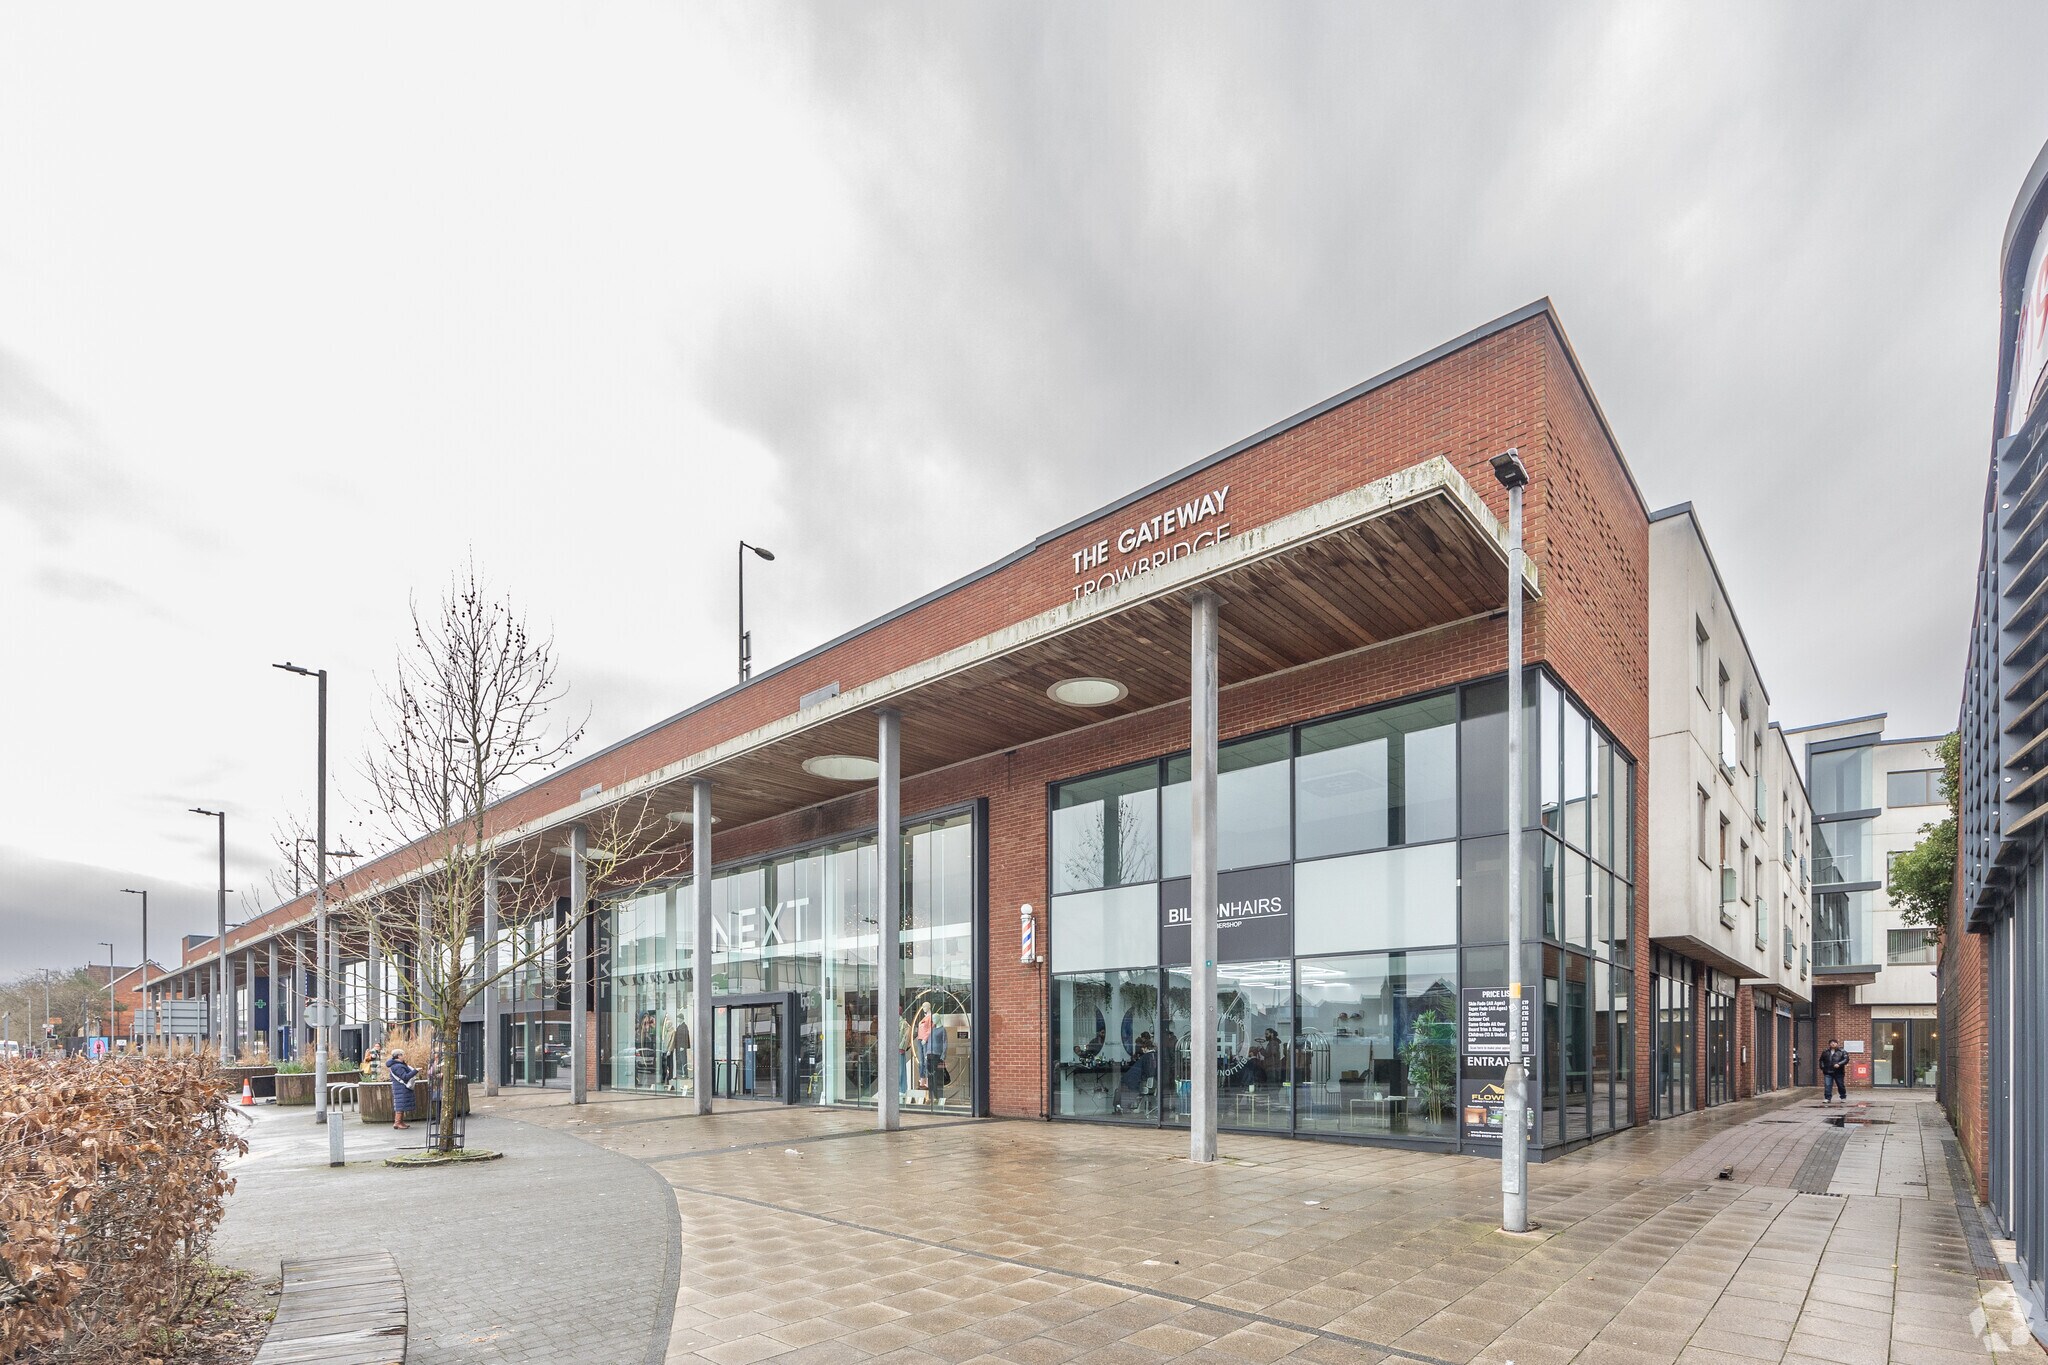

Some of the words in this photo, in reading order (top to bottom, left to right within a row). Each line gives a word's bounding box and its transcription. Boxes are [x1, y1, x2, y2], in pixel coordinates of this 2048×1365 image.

[1072, 539, 1109, 574] THE
[1117, 485, 1230, 554] GATEWAY
[1168, 896, 1282, 923] BILNHAIRS
[711, 897, 809, 953] NEXT
[1482, 990, 1500, 998] PRICE
[1501, 990, 1510, 998] LIS
[1467, 1056, 1530, 1067] ENTRANE
